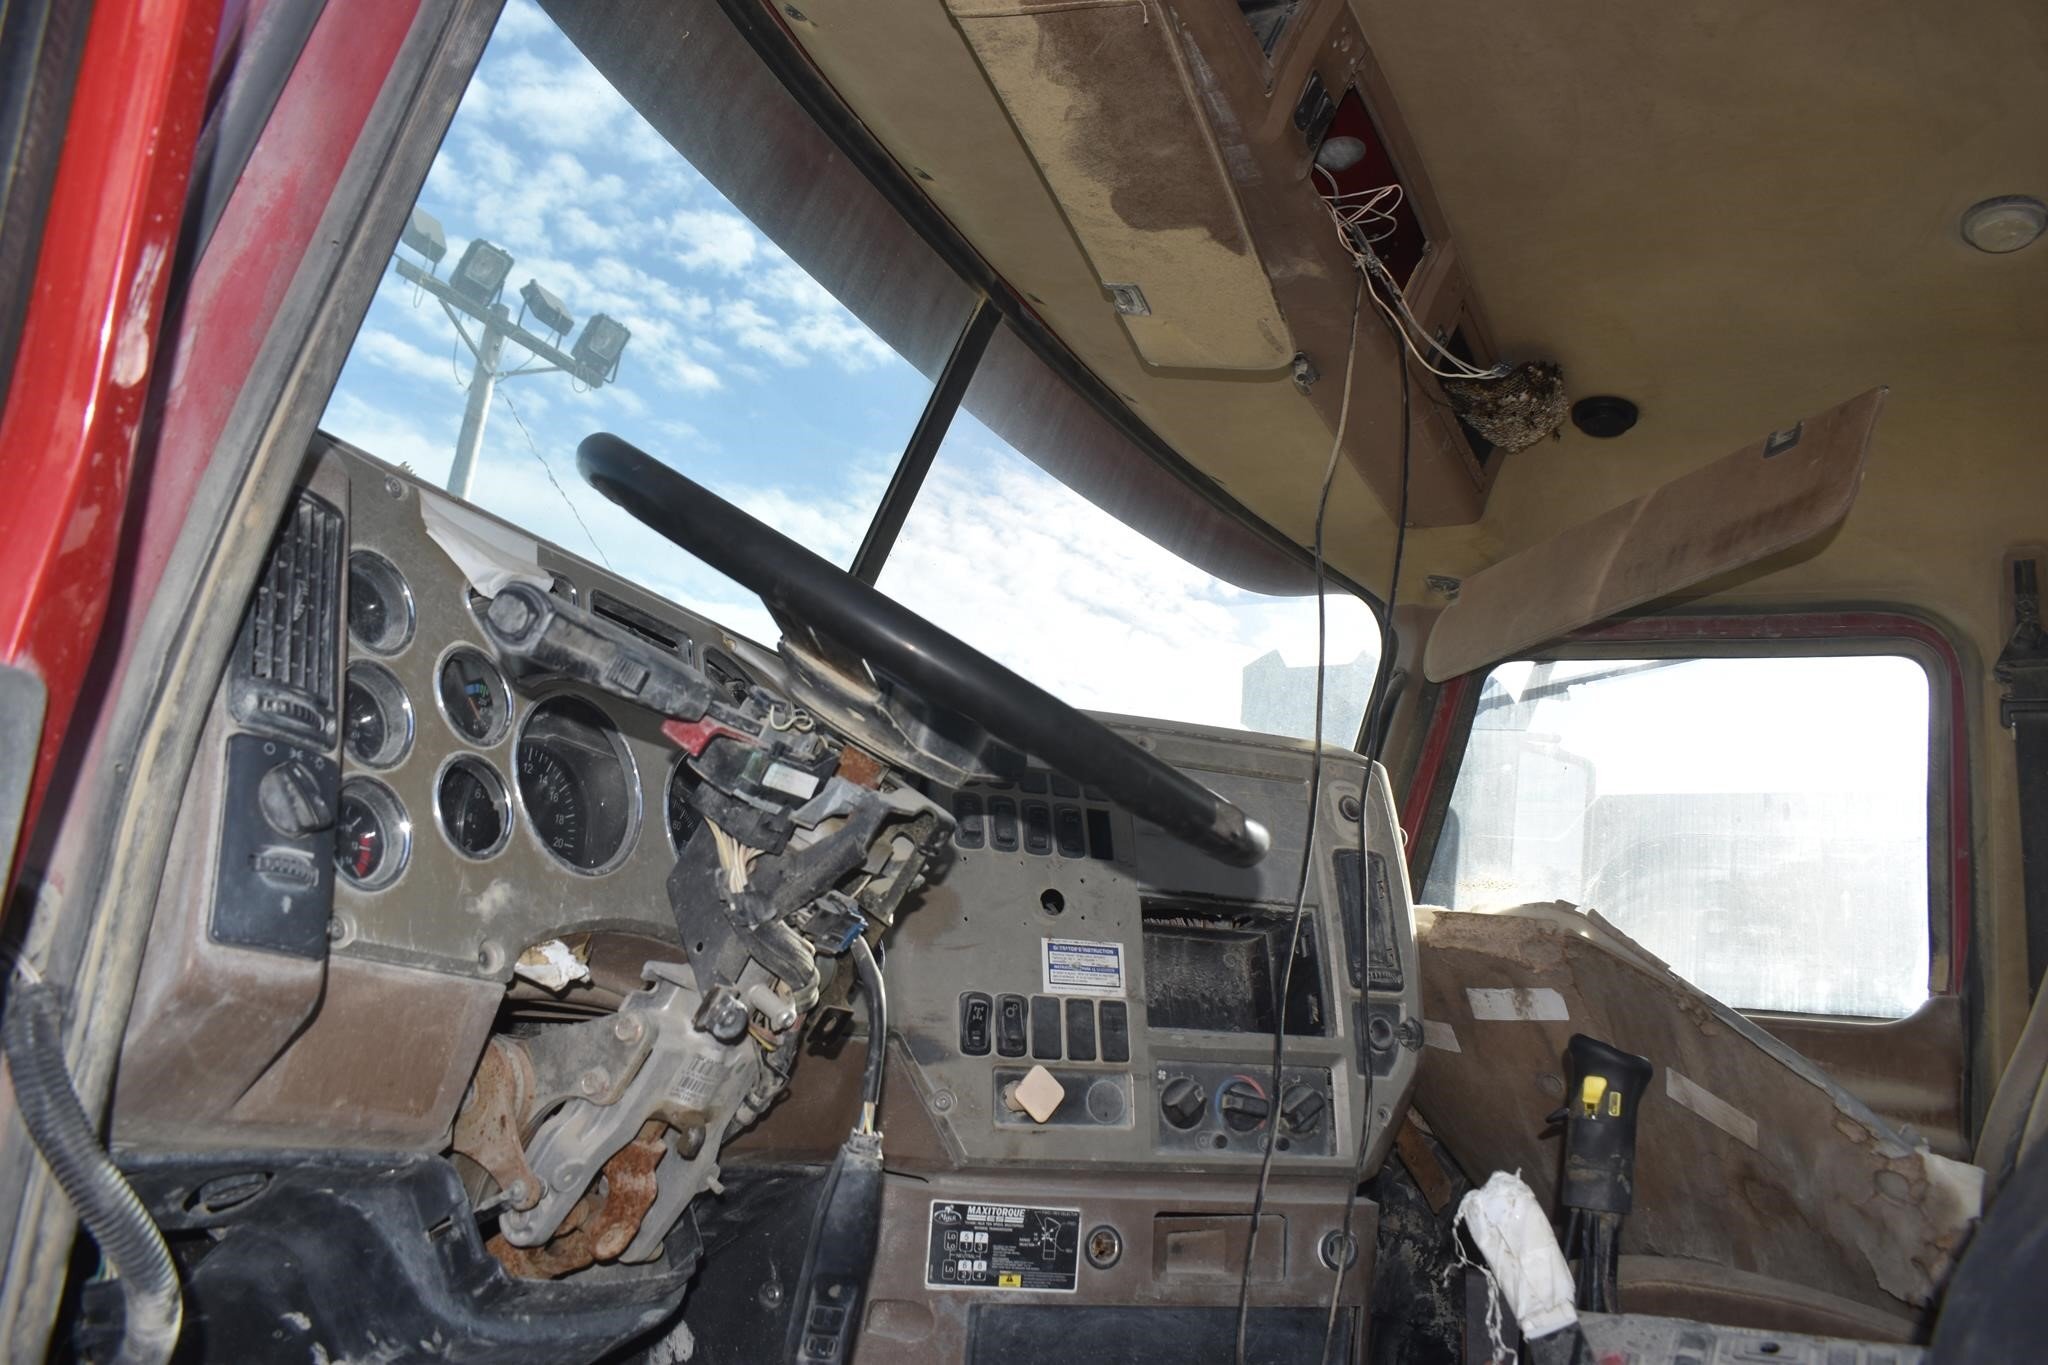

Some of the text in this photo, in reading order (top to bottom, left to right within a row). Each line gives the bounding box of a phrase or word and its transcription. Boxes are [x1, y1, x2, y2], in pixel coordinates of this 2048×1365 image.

[524, 762, 533, 774] 12
[539, 774, 548, 785] 14
[474, 788, 481, 799] 6
[550, 791, 559, 802] 16
[555, 813, 565, 825] 18
[553, 836, 564, 848] 20
[968, 1206, 1026, 1217] MAXITORQUE
[947, 1231, 956, 1240] Lo
[979, 1233, 984, 1241] 7
[945, 1265, 954, 1273] Lo
